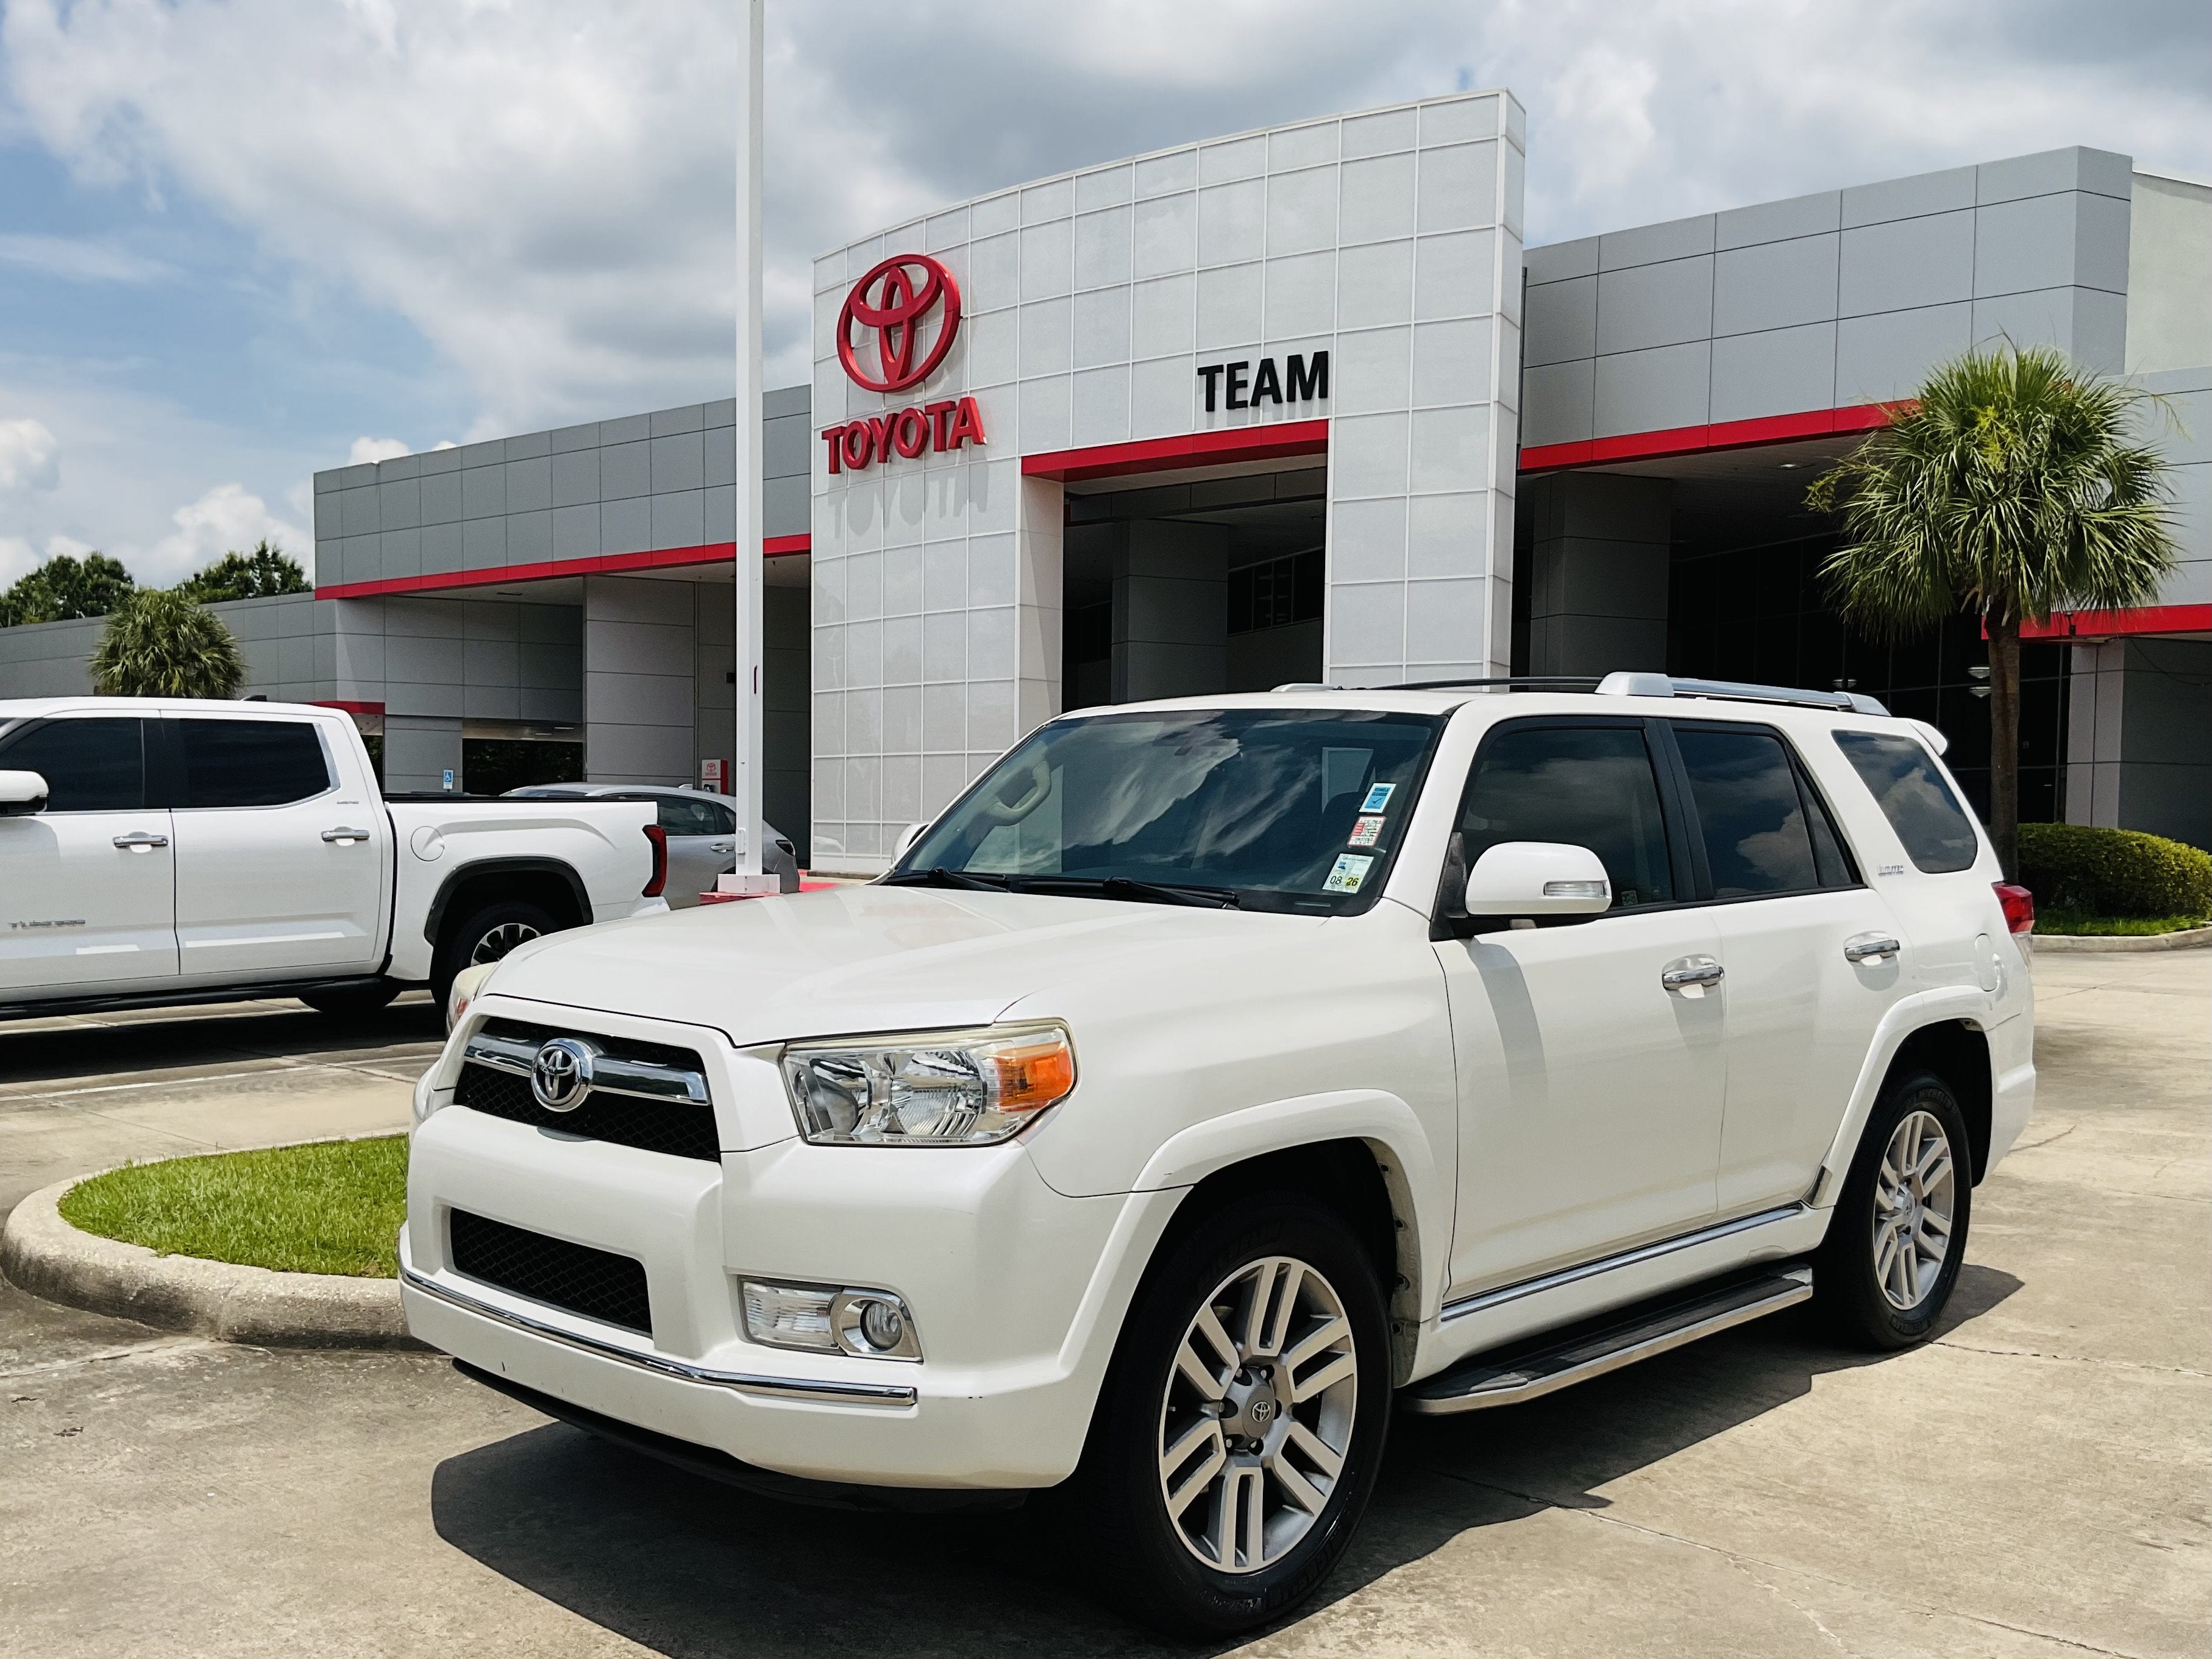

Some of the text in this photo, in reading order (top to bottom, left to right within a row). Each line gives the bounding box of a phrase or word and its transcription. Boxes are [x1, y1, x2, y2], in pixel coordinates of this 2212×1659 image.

[1198, 350, 1328, 412] TEAM
[822, 397, 987, 474] TOYOTA
[1330, 876, 1359, 886] 08 26
